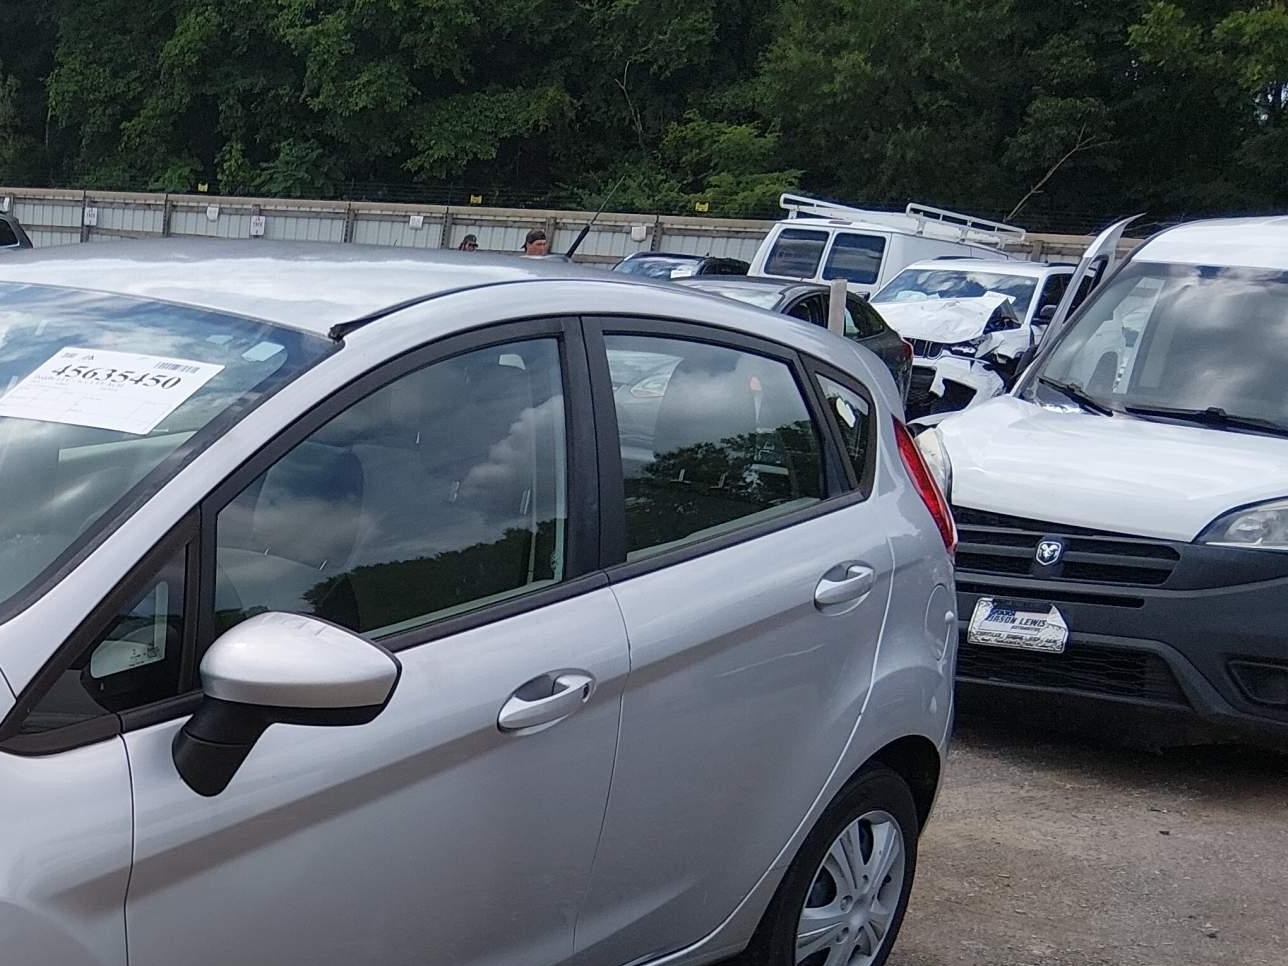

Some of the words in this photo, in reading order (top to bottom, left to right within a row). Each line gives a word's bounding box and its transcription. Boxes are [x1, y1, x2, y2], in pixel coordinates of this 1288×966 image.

[51, 364, 182, 390] 45635450
[989, 614, 1017, 625] JASON
[1018, 617, 1047, 627] LEWIS
